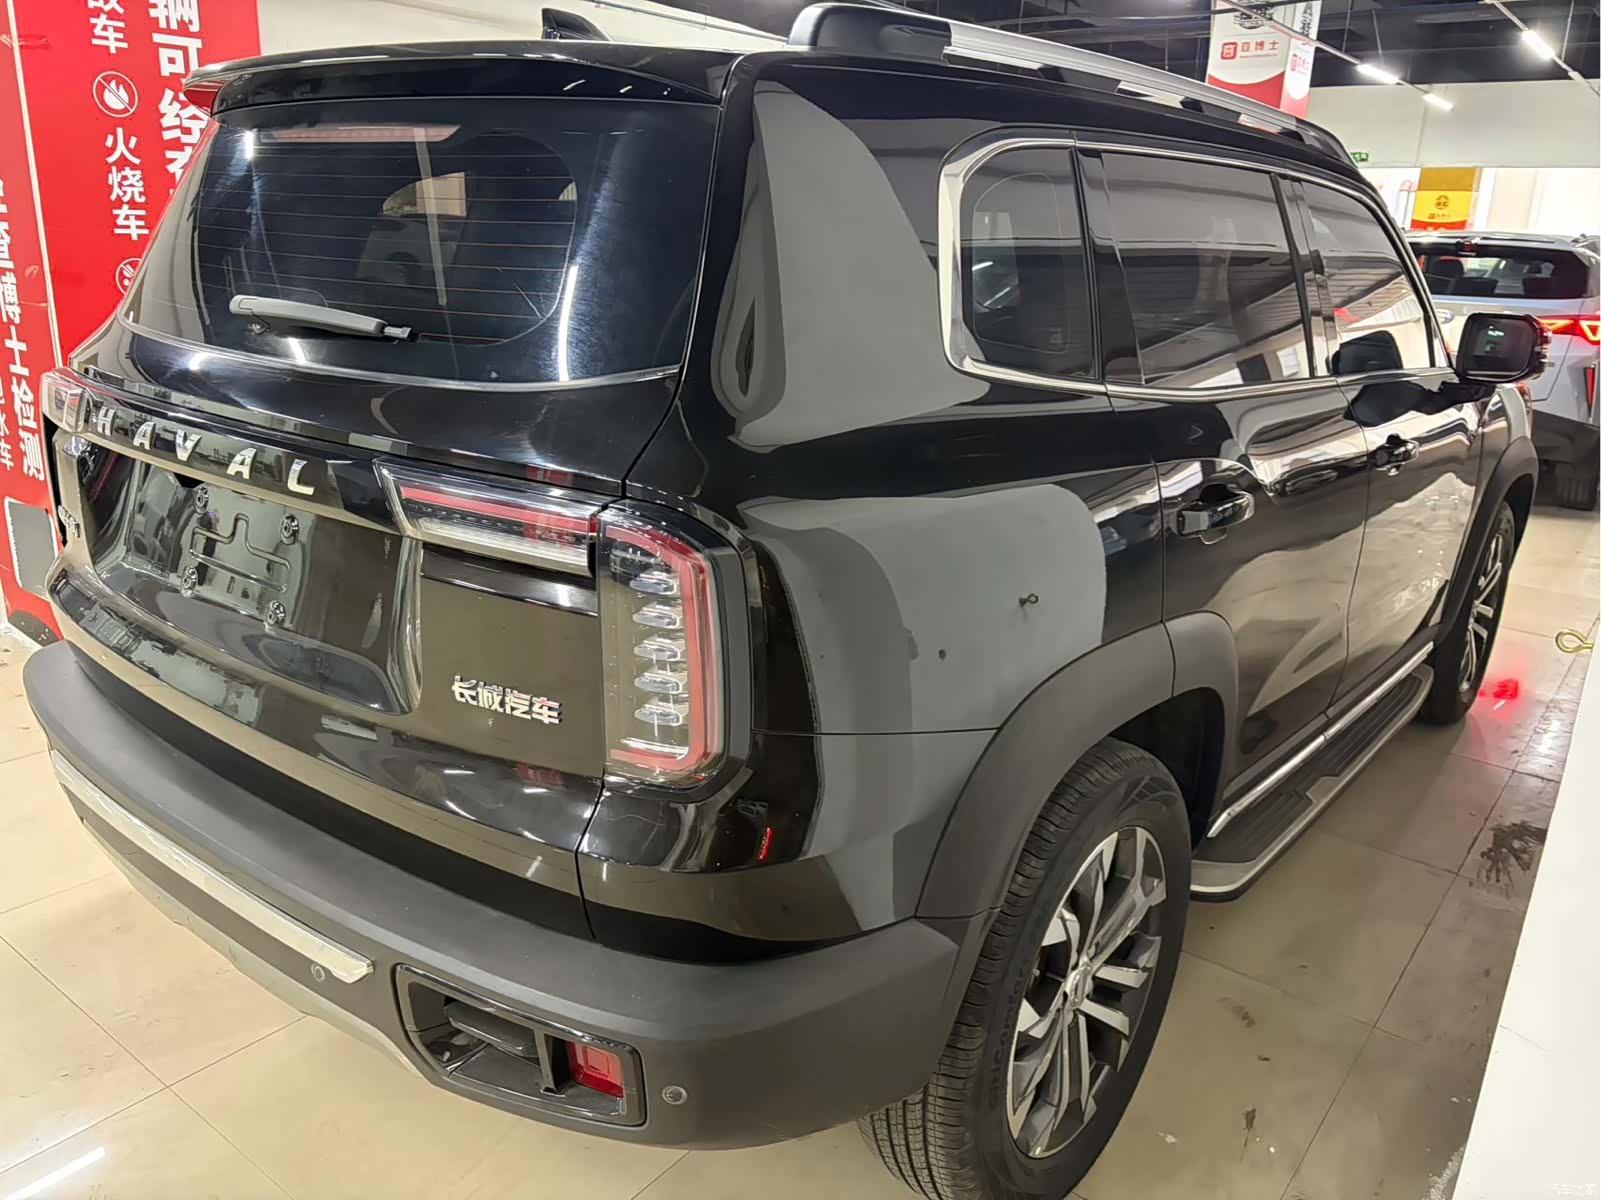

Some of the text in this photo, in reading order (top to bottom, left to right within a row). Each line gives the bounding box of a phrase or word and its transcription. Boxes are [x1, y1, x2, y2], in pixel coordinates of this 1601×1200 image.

[104, 127, 150, 241] 火烧车
[99, 406, 316, 495] HAVAL
[451, 674, 562, 725] 长城汽车
